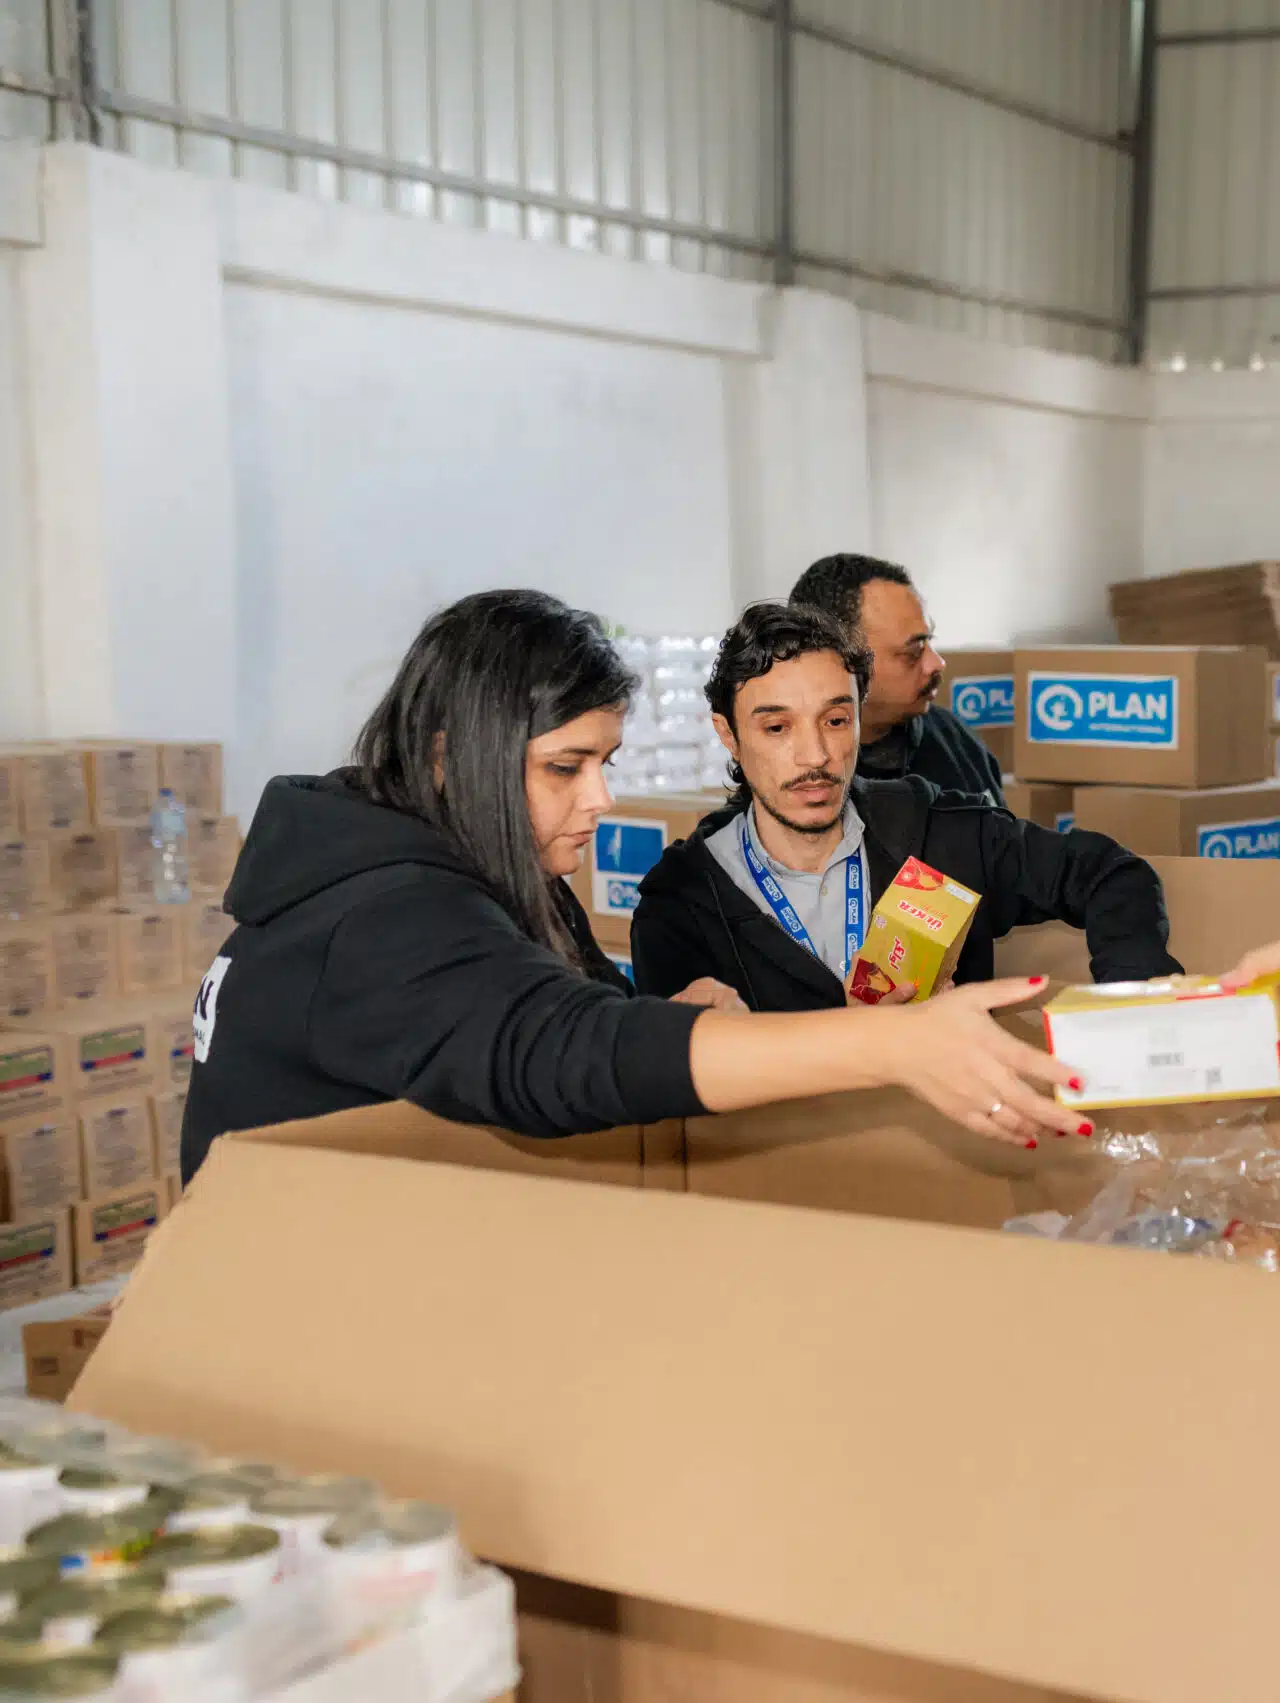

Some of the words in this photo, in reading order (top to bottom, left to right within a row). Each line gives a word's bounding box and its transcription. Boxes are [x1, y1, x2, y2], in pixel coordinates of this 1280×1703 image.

[987, 688, 1014, 708] PL
[1088, 691, 1167, 720] PLAN
[1235, 831, 1280, 856] PLAN
[899, 901, 943, 930] ÜLKER
